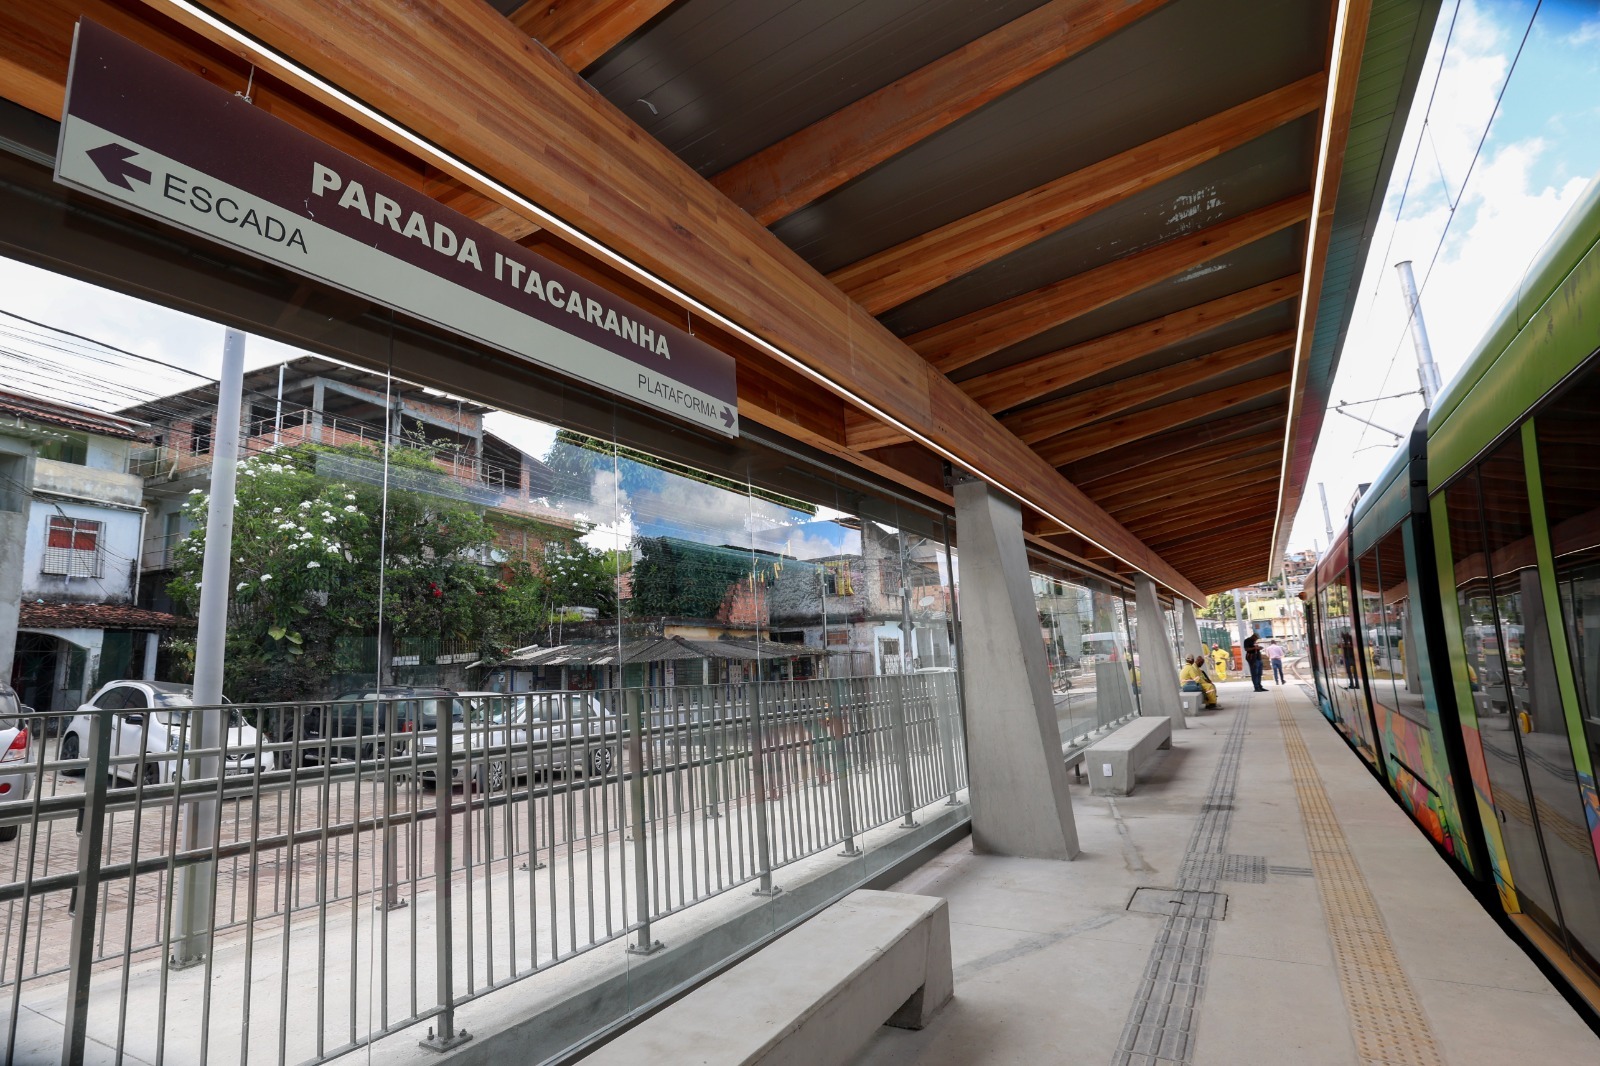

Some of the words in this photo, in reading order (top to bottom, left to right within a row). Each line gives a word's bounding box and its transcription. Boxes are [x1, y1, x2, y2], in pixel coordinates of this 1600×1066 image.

[163, 172, 308, 255] ESCADA
[311, 161, 483, 272] PARADA
[494, 251, 671, 361] ITACARANHA
[638, 373, 718, 420] PLATAFORMA
